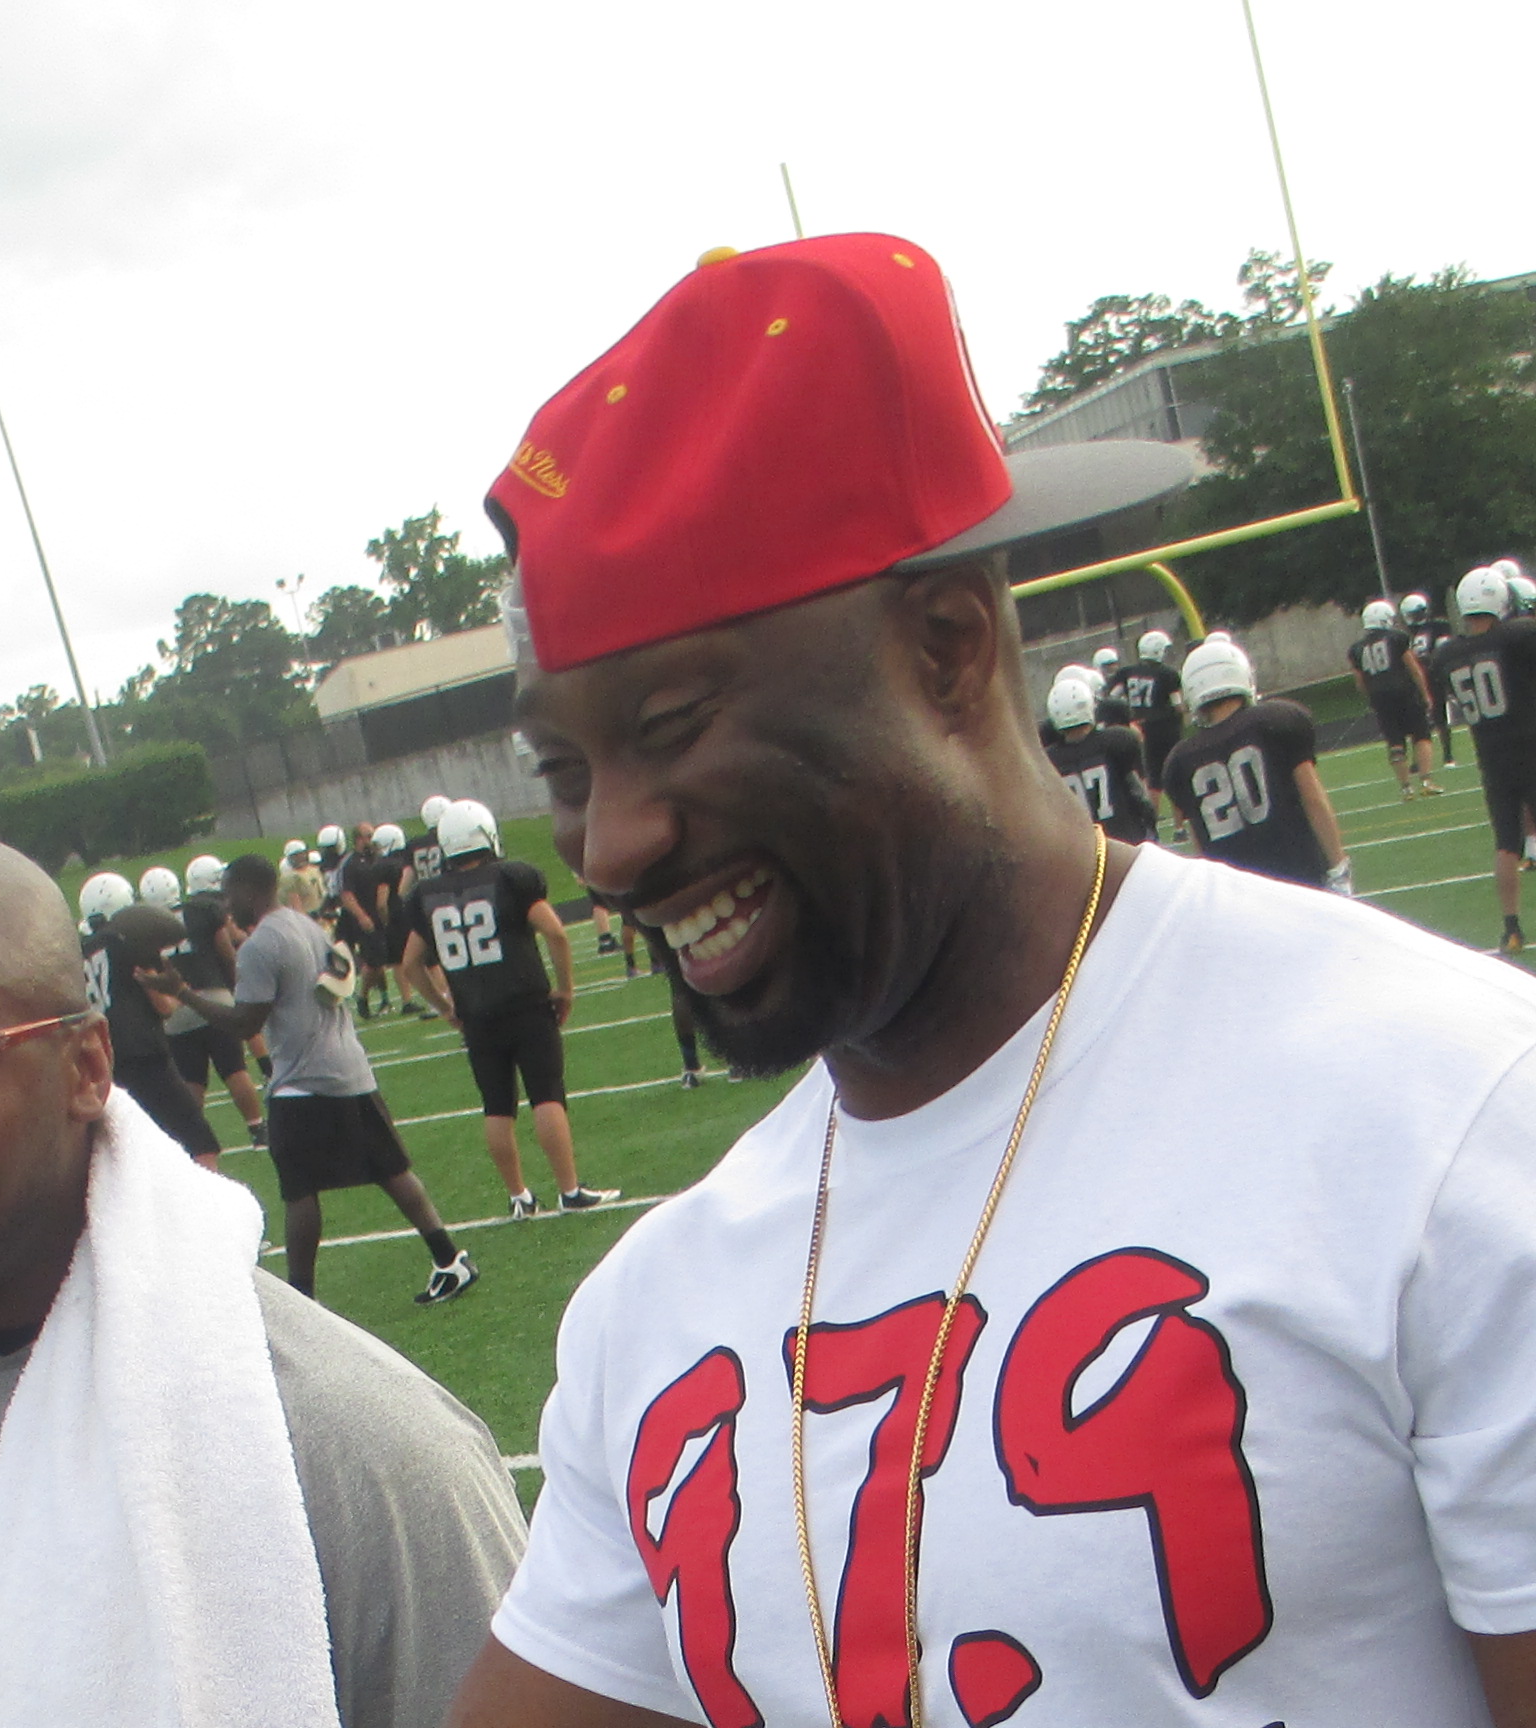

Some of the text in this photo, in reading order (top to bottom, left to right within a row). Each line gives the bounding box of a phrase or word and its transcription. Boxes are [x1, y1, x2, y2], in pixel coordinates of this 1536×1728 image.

[528, 449, 570, 491] Ness
[1450, 661, 1506, 725] 50
[1192, 745, 1270, 841] 20
[413, 846, 442, 880] 52
[432, 900, 502, 972] 62
